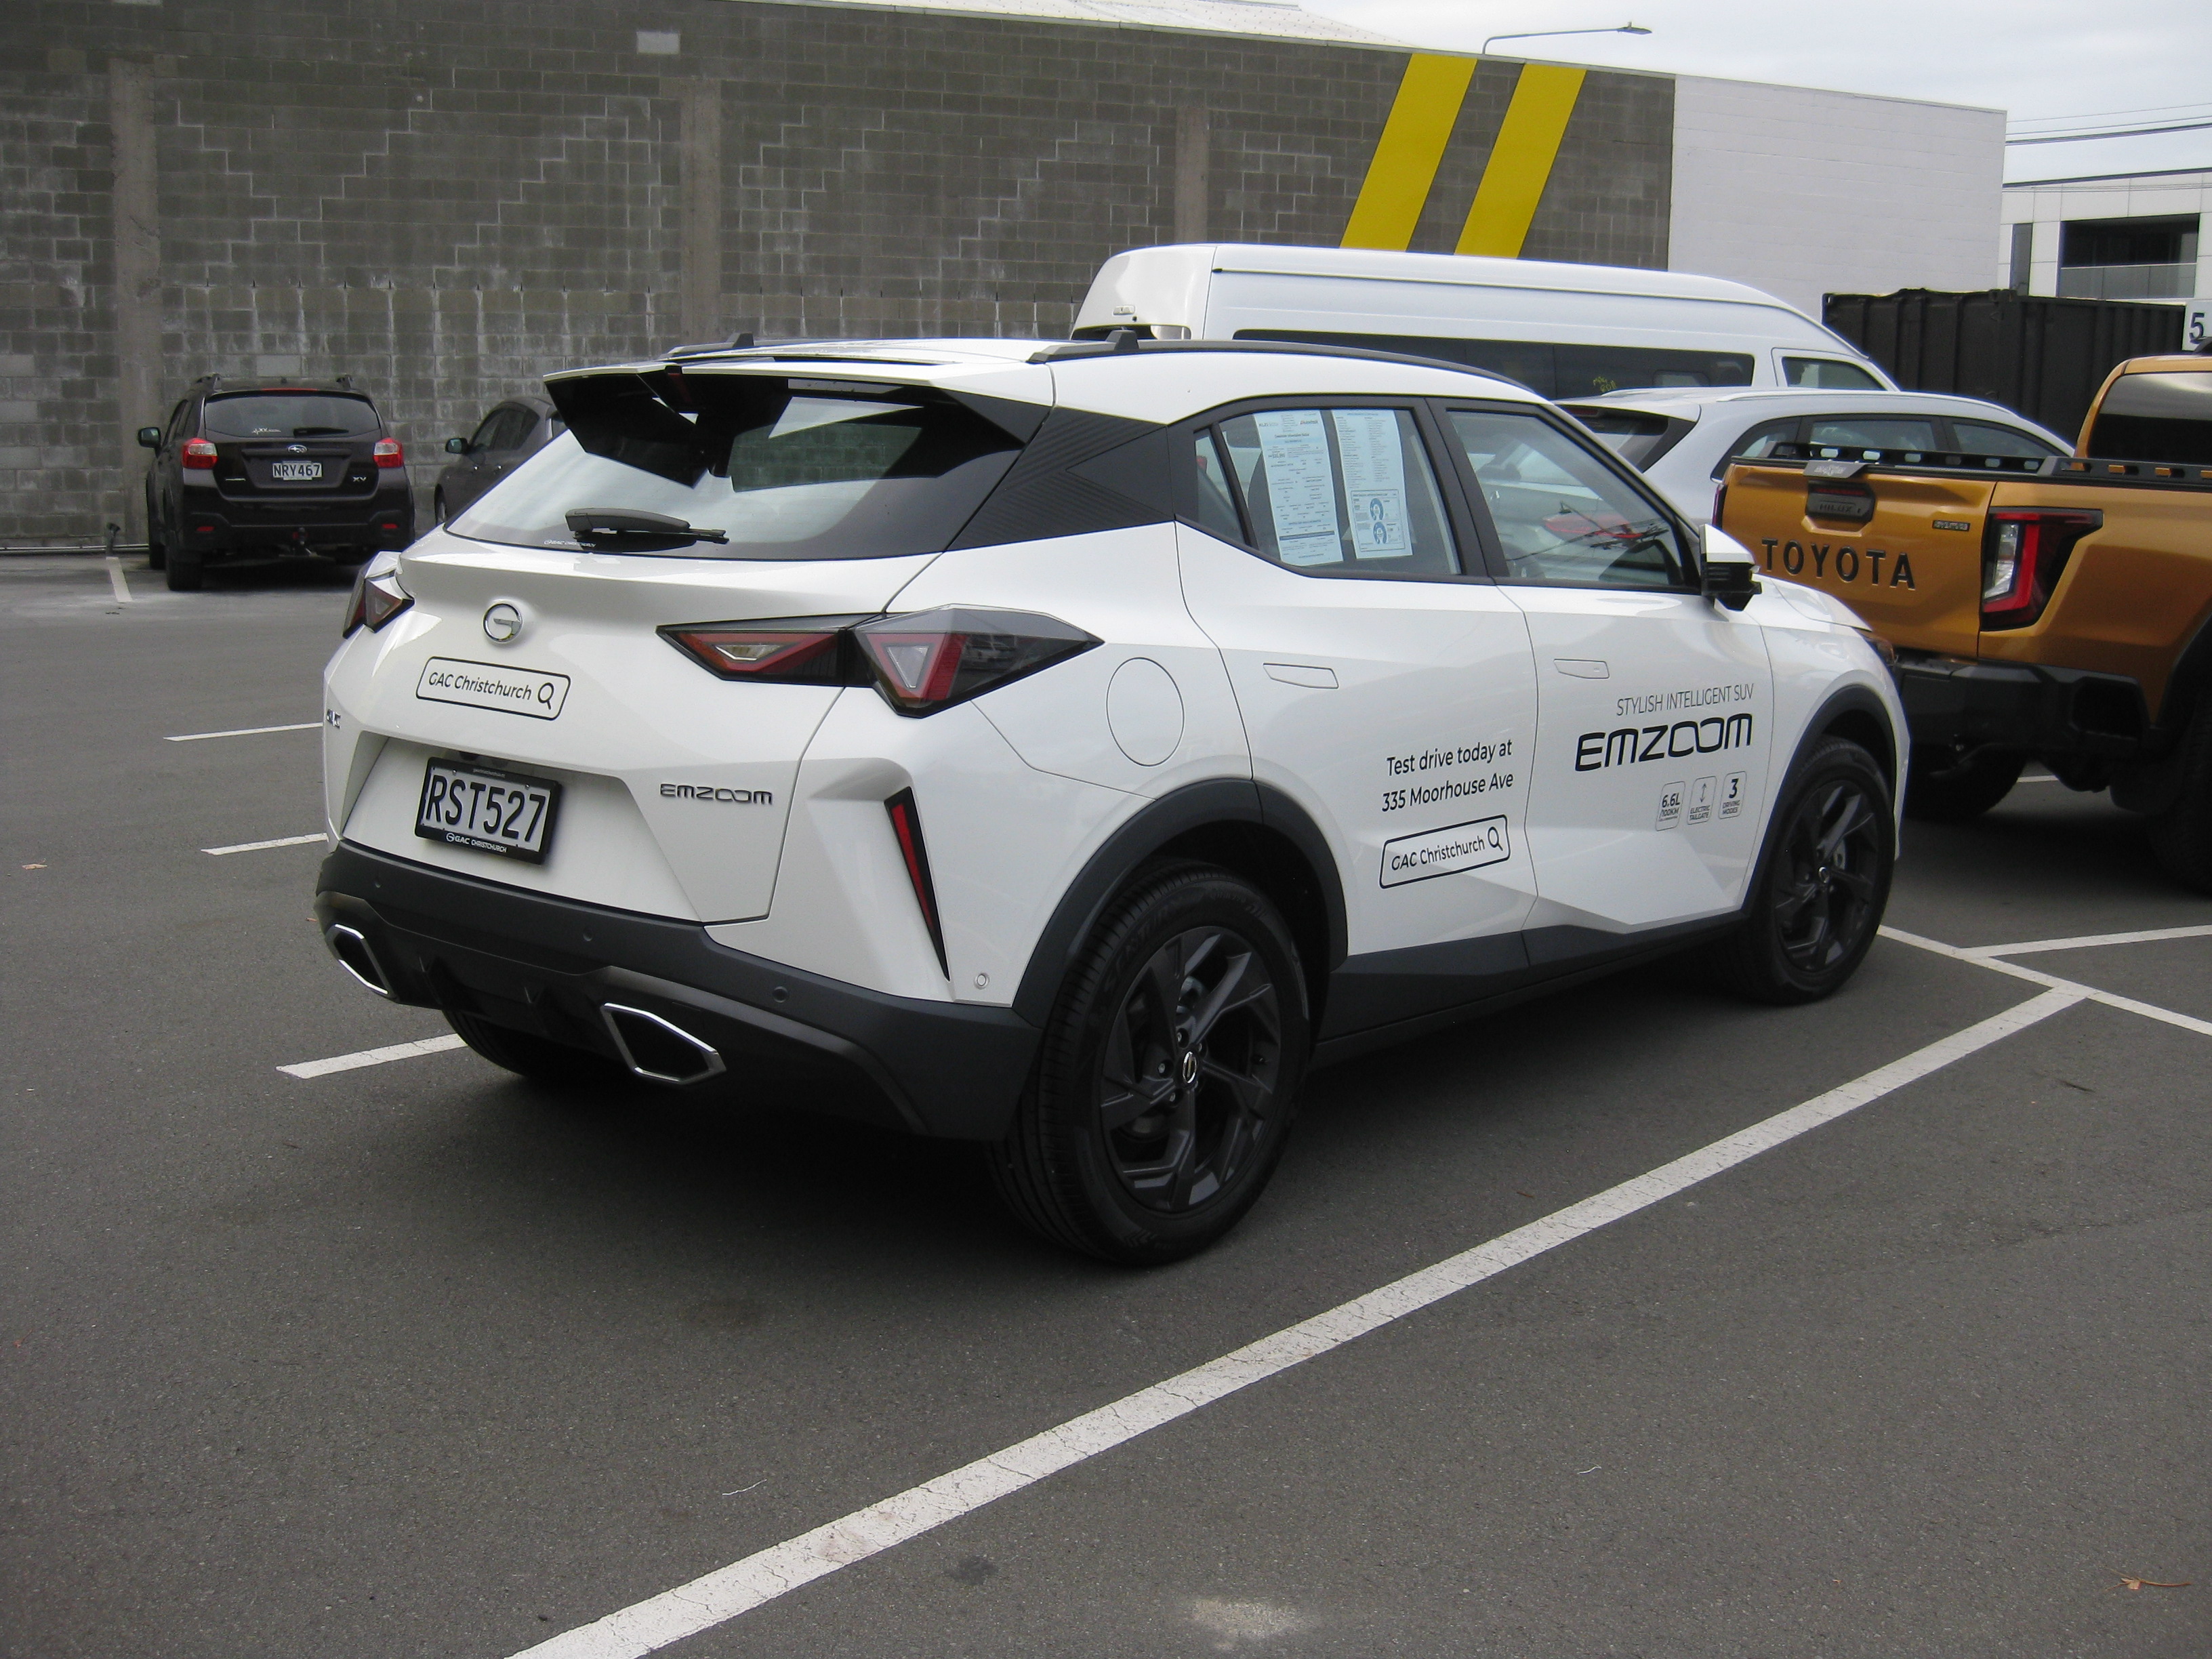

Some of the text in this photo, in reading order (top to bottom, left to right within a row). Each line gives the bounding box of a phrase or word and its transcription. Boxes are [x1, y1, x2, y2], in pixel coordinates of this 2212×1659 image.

[2188, 312, 2205, 345] 5
[274, 464, 321, 476] NRY467
[1819, 504, 1852, 513] HILUX
[1762, 537, 1916, 591] TOYOTA
[428, 672, 532, 700] GAC Christchurch
[1616, 683, 1755, 716] STYLISH INTELLIGENT SUV
[1575, 713, 1753, 771] EMZOOM
[1387, 739, 1513, 777] Test drive today at
[660, 783, 773, 804] EMZOOM
[1382, 773, 1514, 812] 335 Moorhouse Ave
[1729, 778, 1740, 798] 3
[426, 775, 546, 842] RST527
[1662, 792, 1681, 808] 6.6L
[1689, 805, 1711, 814] ELECTRIC
[1722, 800, 1740, 808] DRIVING
[1722, 806, 1738, 815] MODES
[1689, 812, 1709, 820] TAILGATE
[455, 836, 507, 853] GAC CHRISTCHURCH
[1391, 836, 1486, 871] GAC Christchurch
